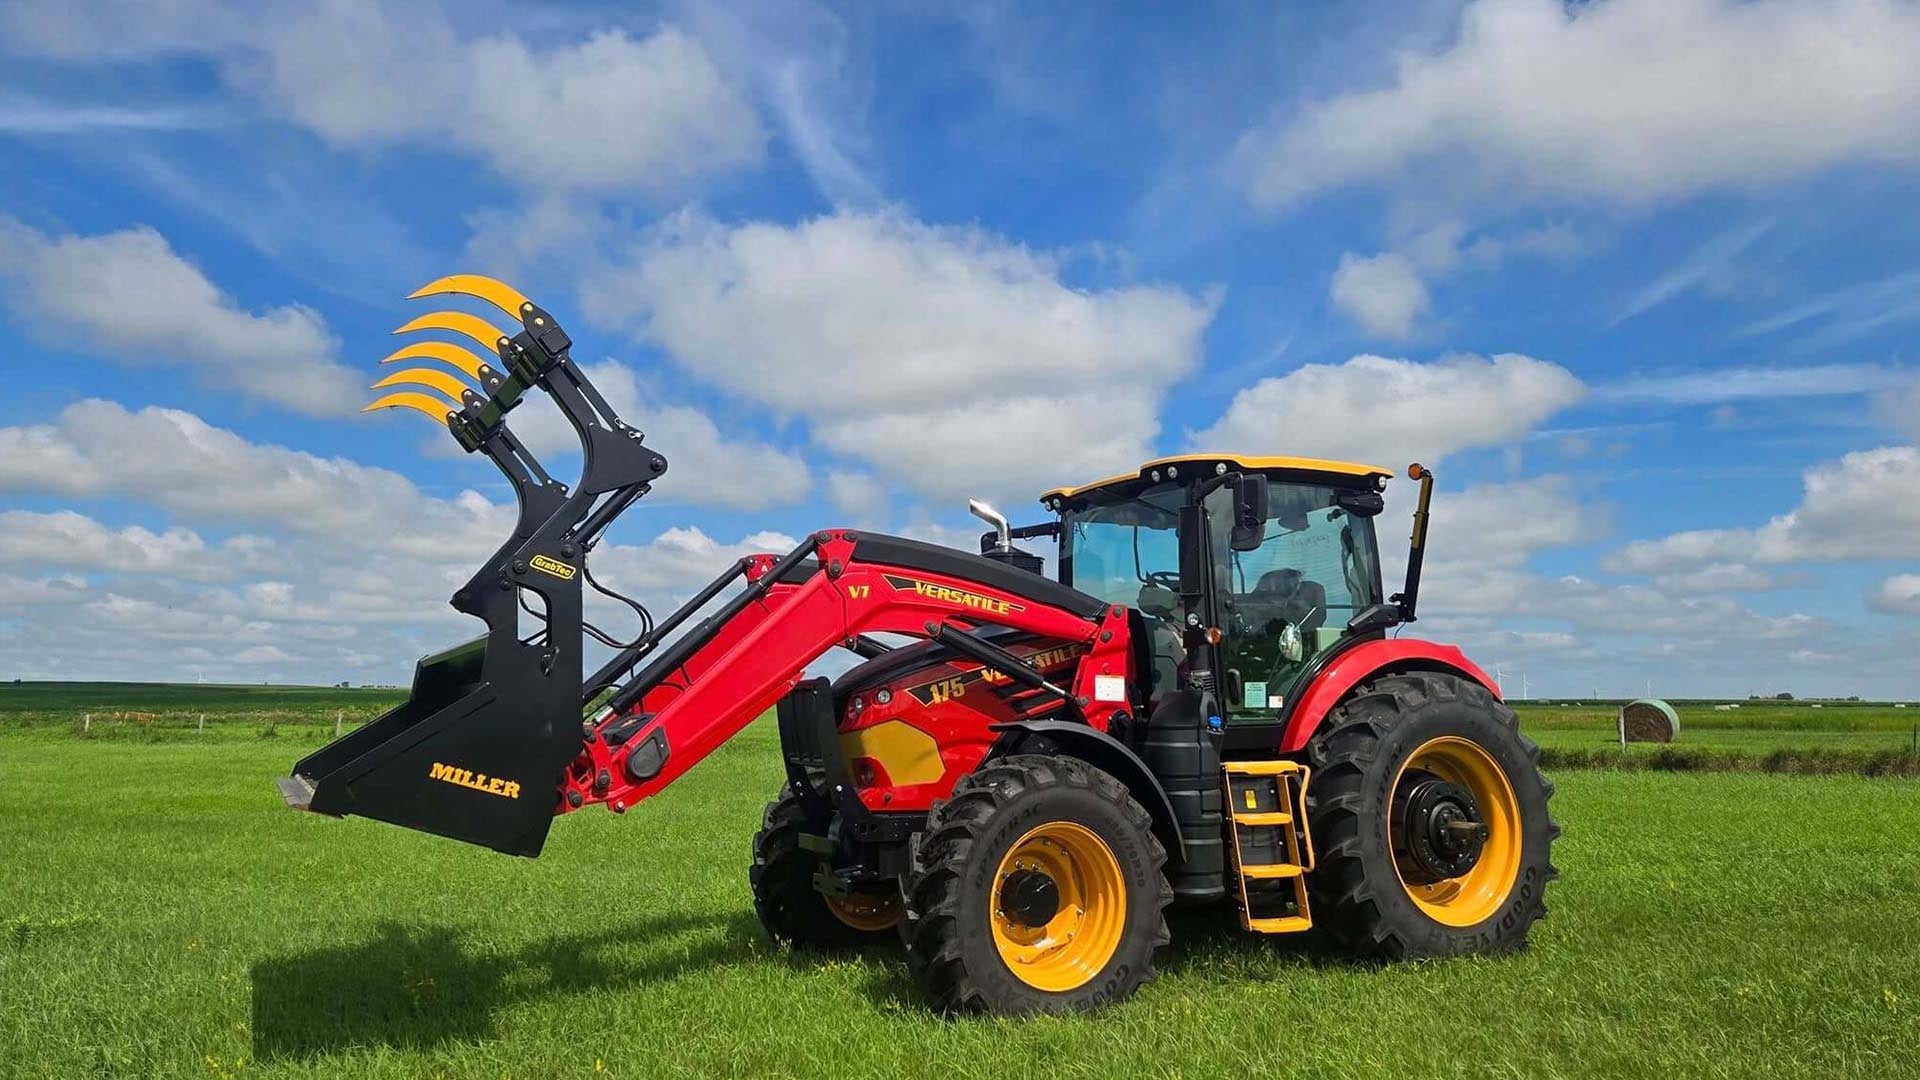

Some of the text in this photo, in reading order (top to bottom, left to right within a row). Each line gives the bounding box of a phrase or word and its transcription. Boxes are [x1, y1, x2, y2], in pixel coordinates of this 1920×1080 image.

[535, 558, 571, 576] GrabTec
[915, 581, 1010, 615] VERSATILE
[930, 677, 966, 704] 175
[429, 762, 521, 799] MILLER
